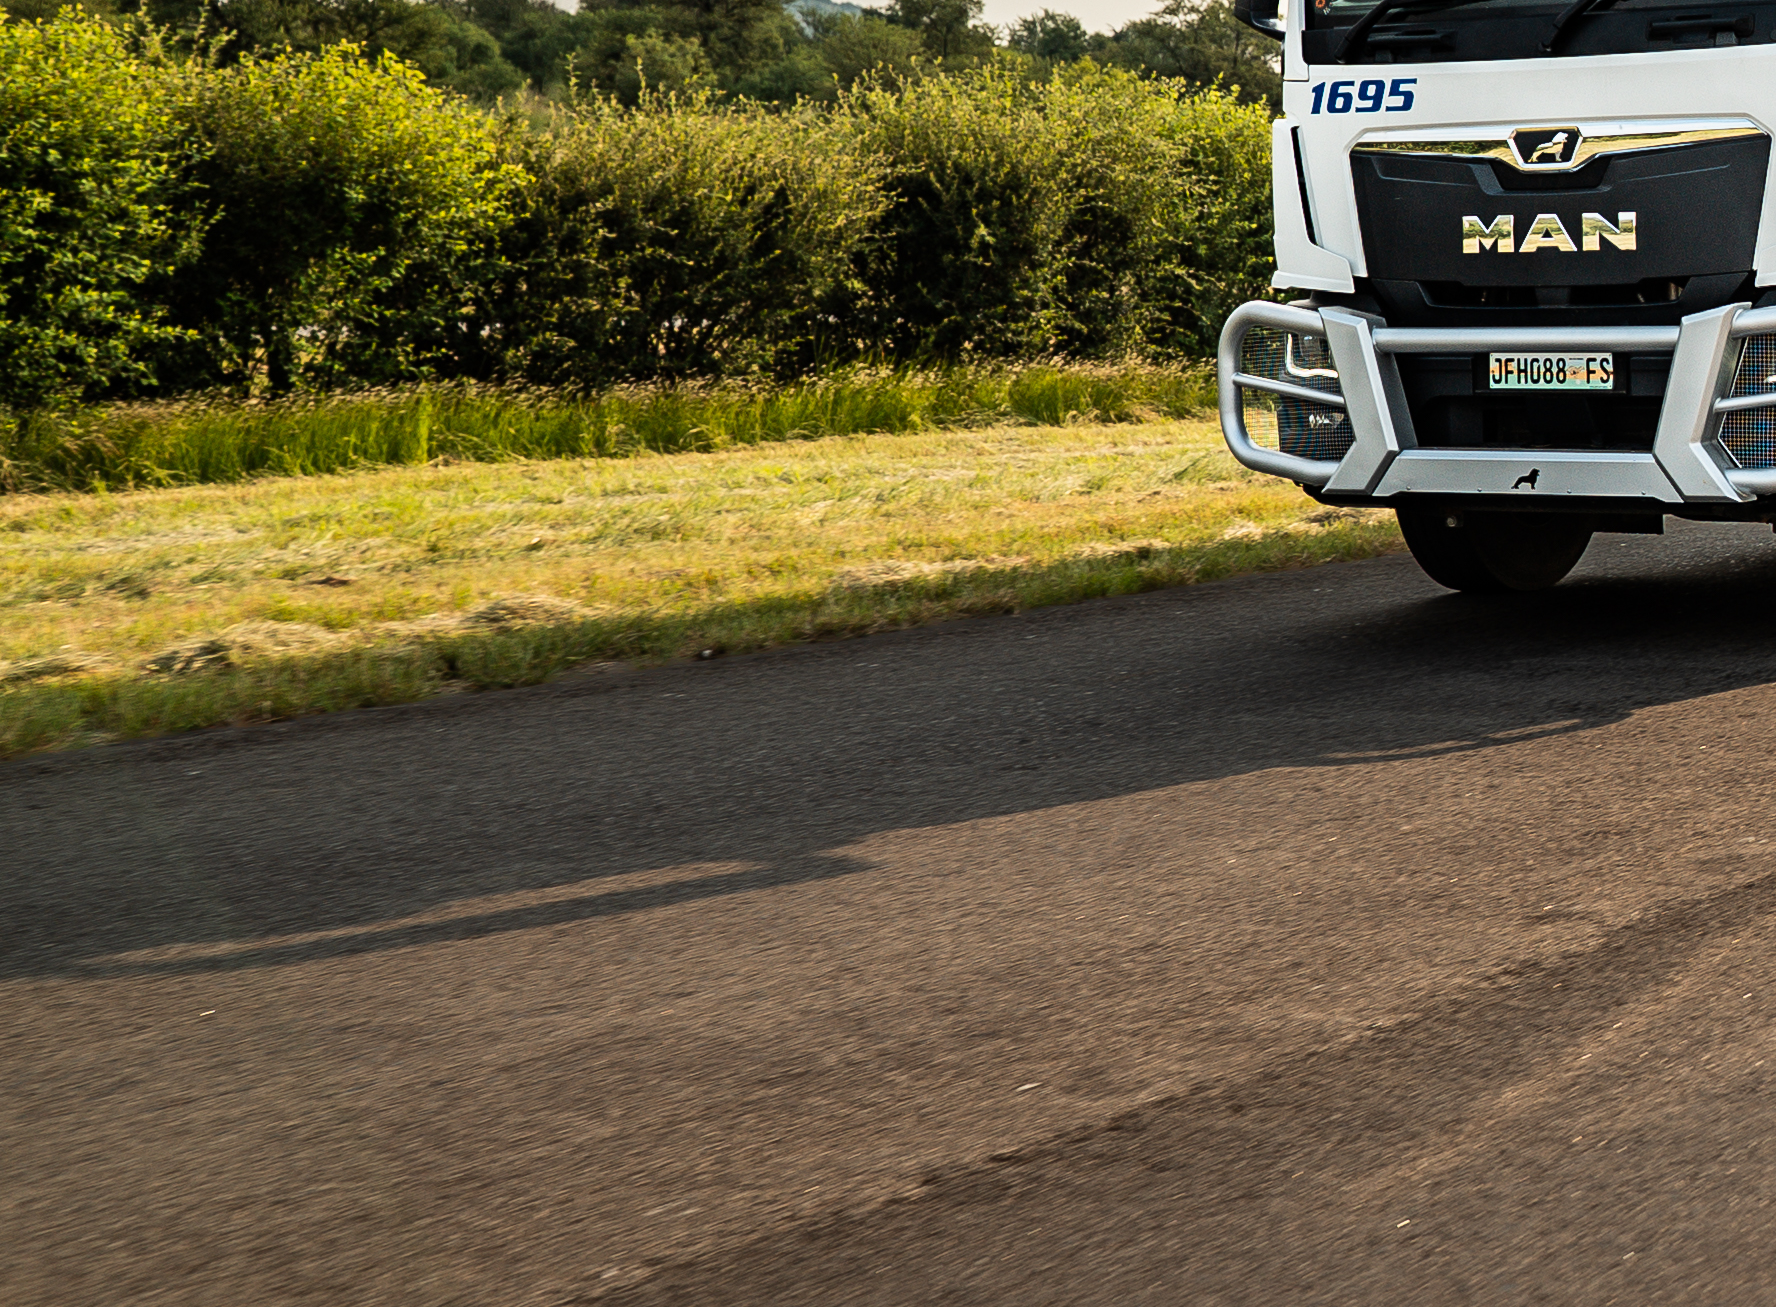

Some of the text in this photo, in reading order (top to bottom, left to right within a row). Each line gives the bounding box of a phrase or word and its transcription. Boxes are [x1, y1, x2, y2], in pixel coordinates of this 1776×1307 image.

[1310, 78, 1418, 115] 1695
[1462, 211, 1637, 254] MAN
[1586, 357, 1610, 384] FS
